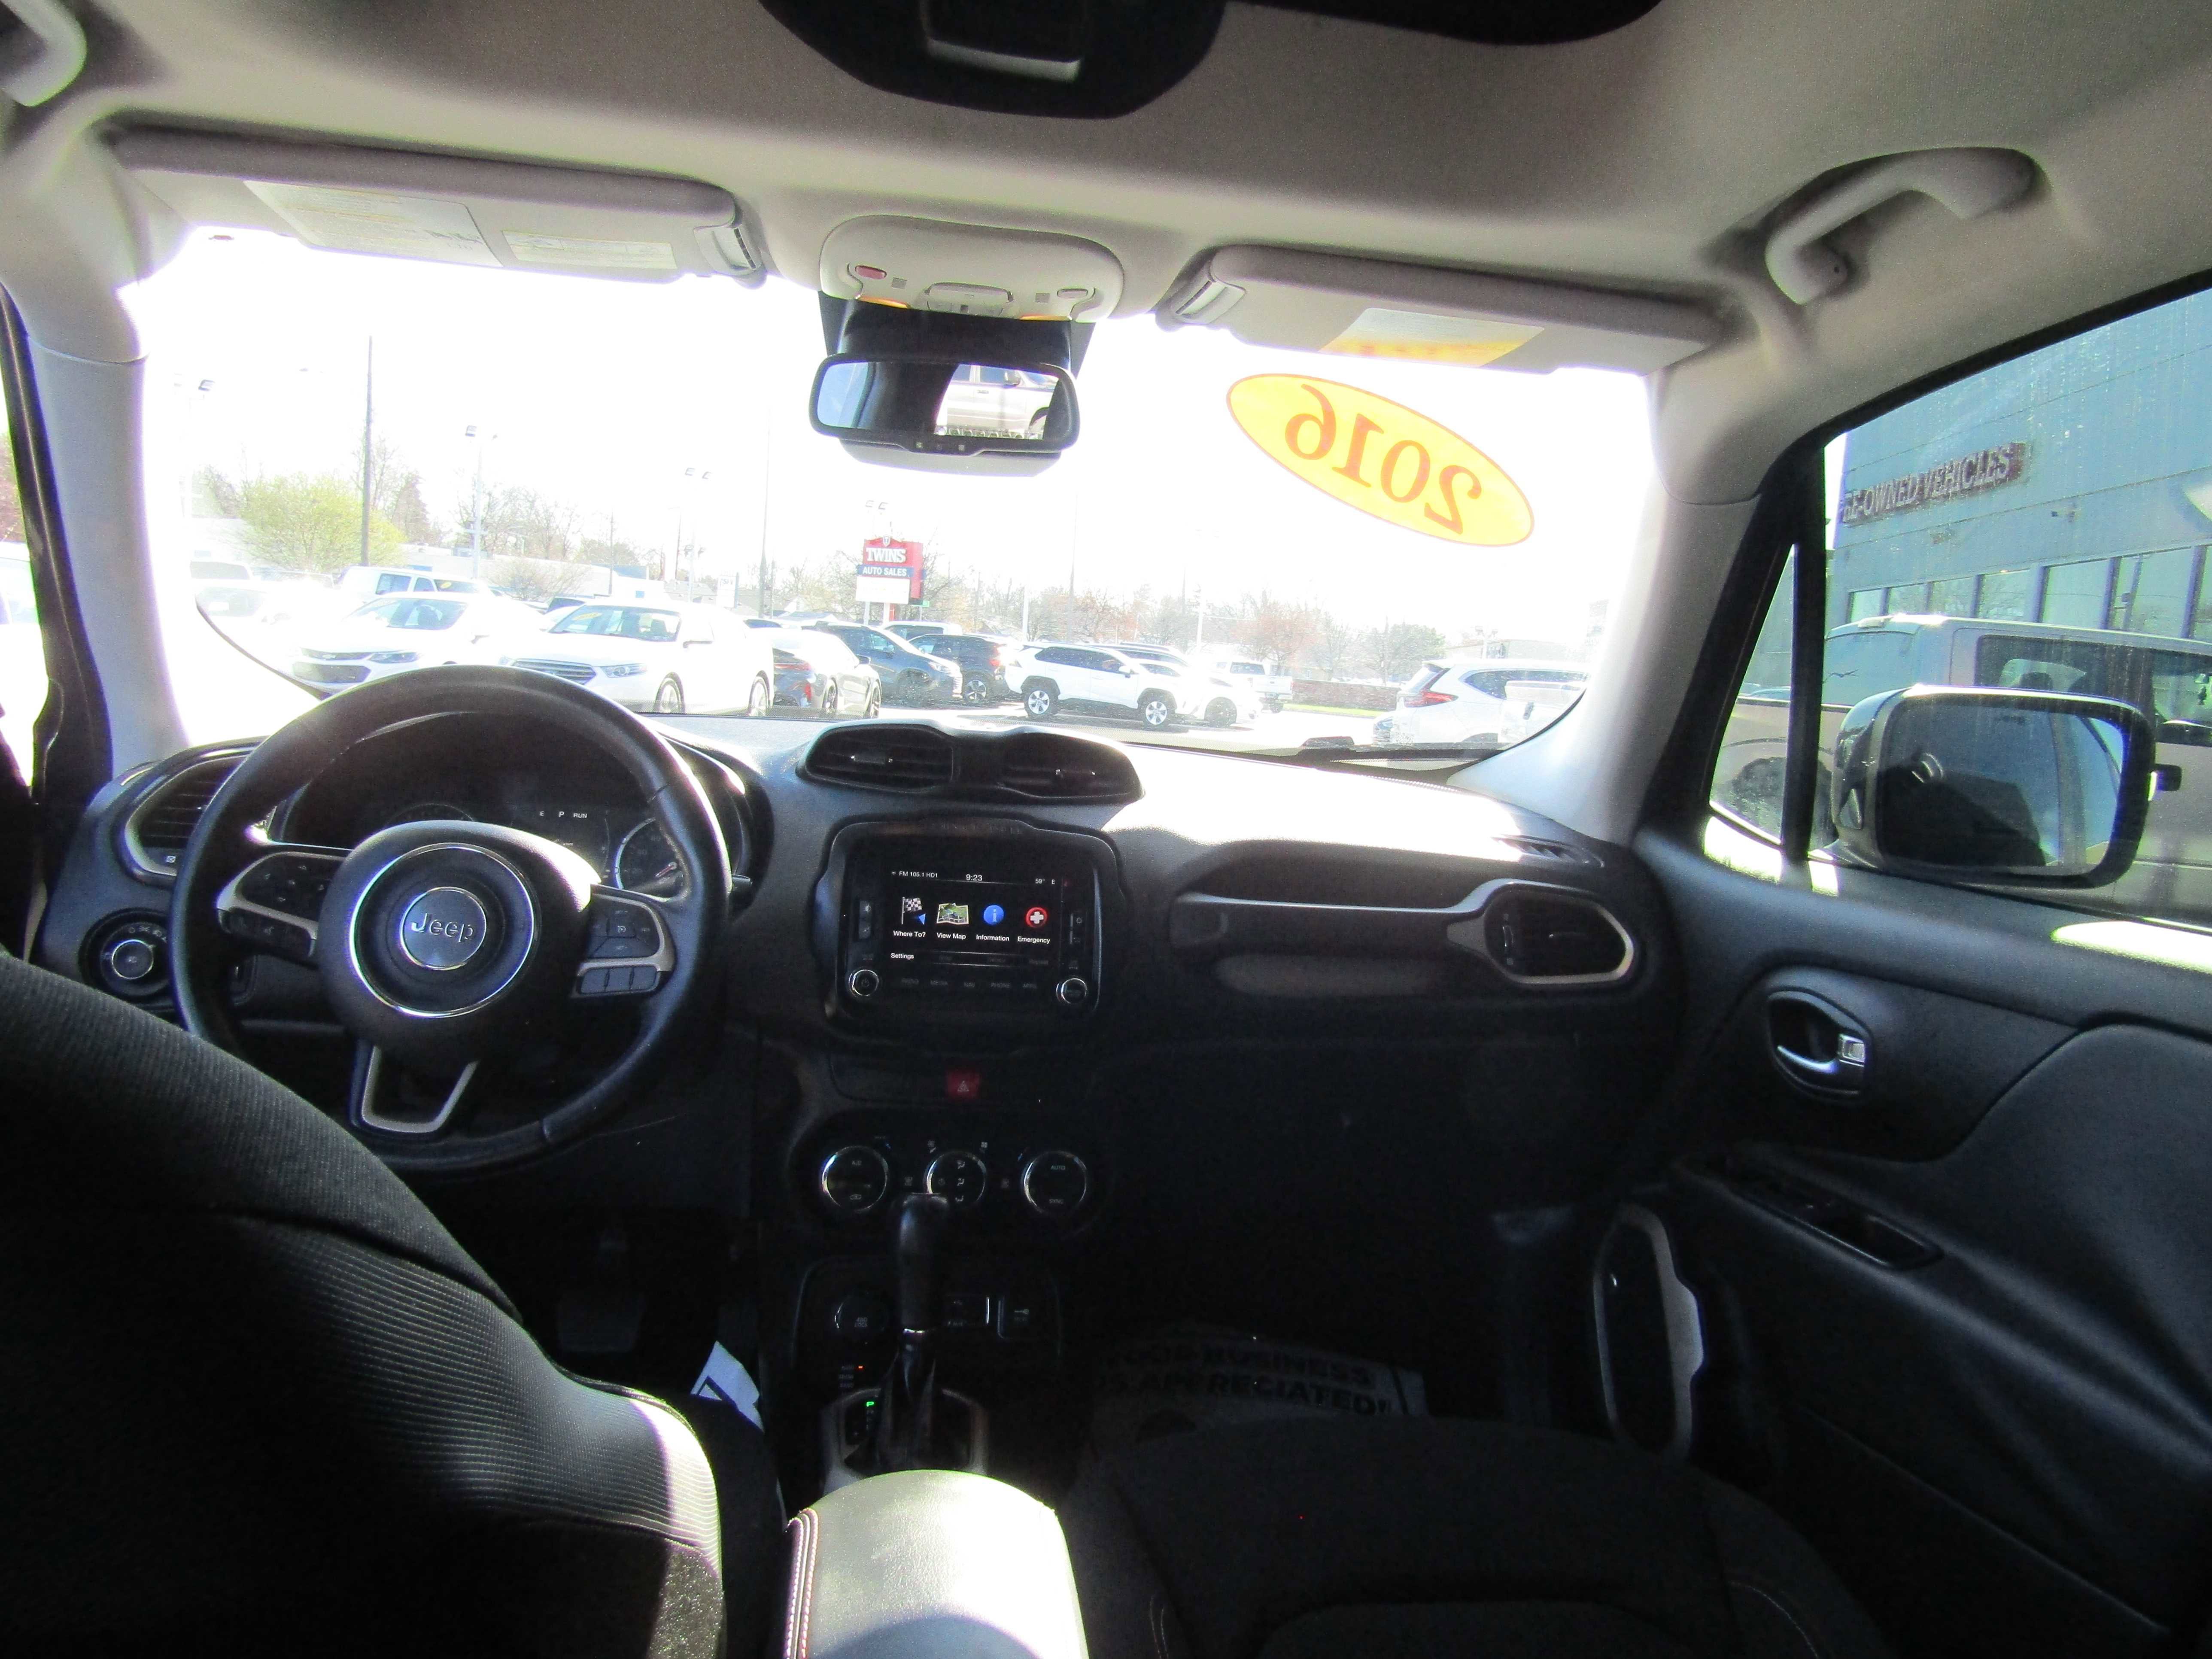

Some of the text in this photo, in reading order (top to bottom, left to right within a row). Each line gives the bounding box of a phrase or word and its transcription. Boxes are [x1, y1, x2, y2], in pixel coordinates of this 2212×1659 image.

[1924, 445, 2012, 499] VEHICLES
[866, 547, 906, 563] TWINS
[863, 567, 907, 576] AUTO SALES
[412, 913, 474, 942] Jeep
[1017, 936, 1050, 944] Emergency
